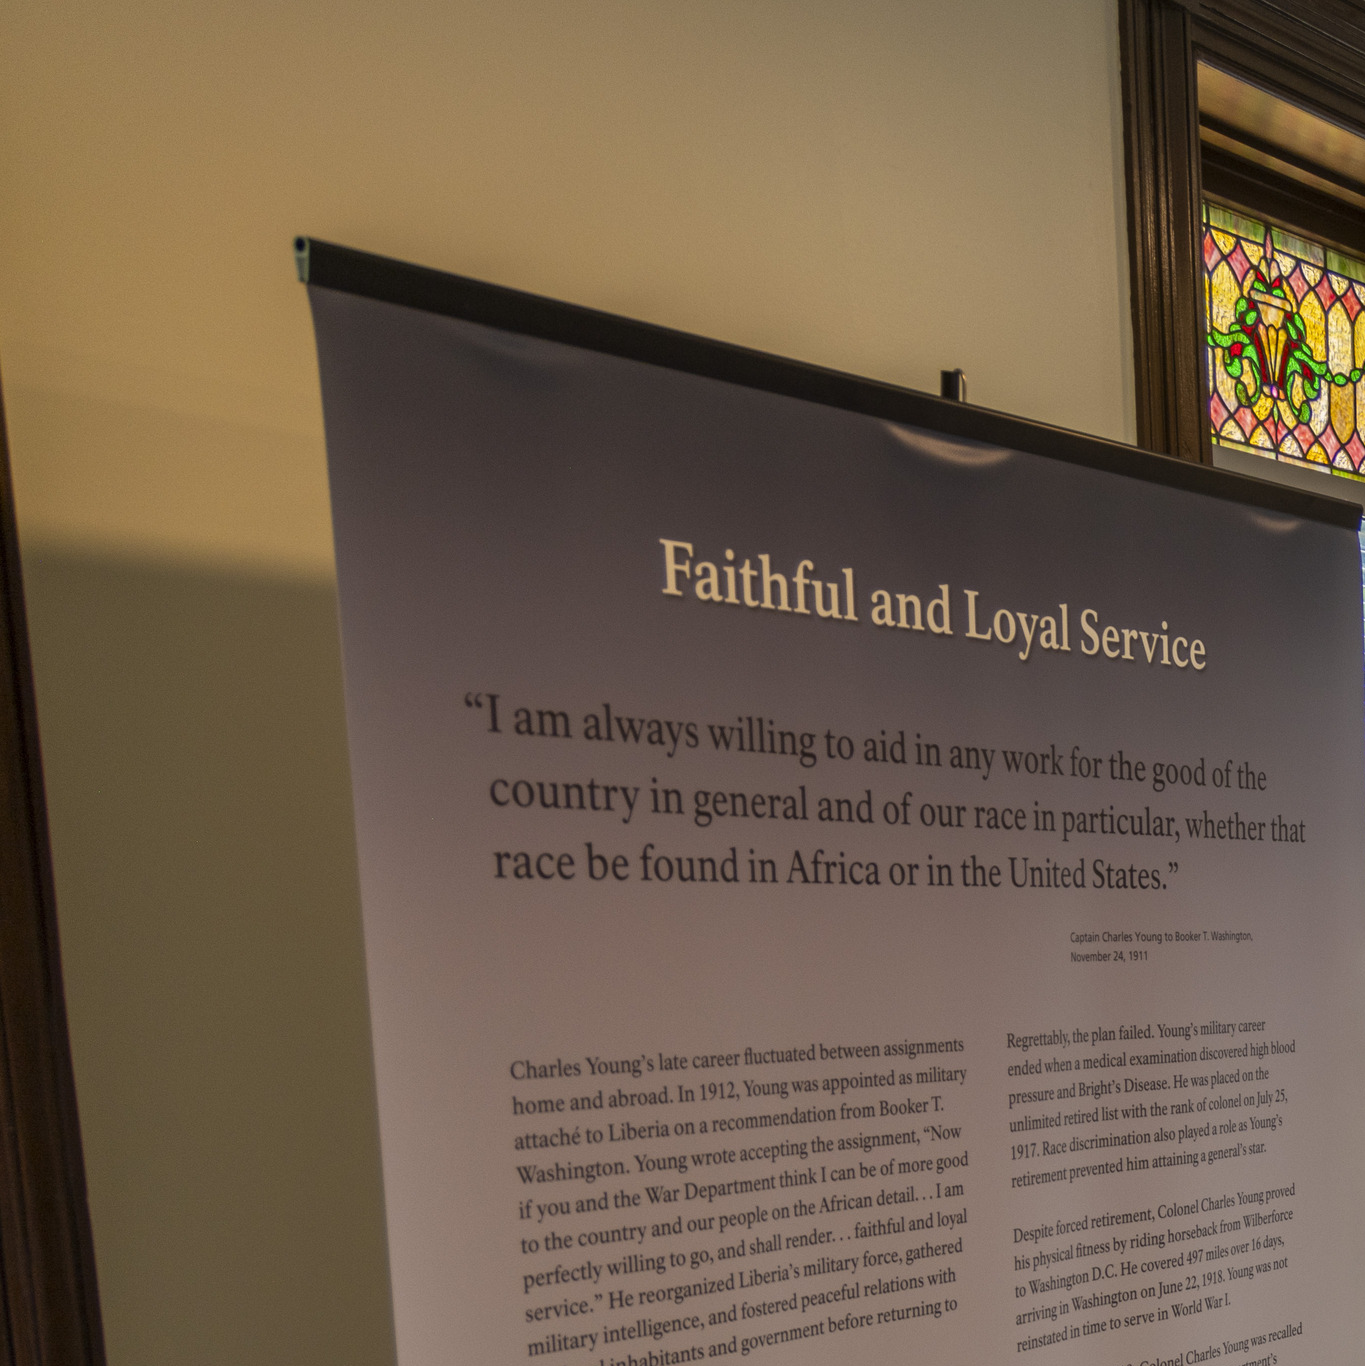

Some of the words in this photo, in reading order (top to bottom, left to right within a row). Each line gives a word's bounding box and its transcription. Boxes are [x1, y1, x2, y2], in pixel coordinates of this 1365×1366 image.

[659, 538, 858, 620] Faithful
[871, 584, 953, 634] and
[964, 589, 1071, 659] Loyal
[1080, 609, 1206, 669] Service
[464, 692, 502, 733] “I
[514, 708, 572, 739] am
[583, 703, 699, 758] always
[707, 716, 817, 768] willing
[824, 729, 855, 760] to
[864, 730, 907, 764] aid
[915, 733, 942, 767] in
[950, 746, 995, 781] any
[1002, 744, 1064, 776] work
[1070, 746, 1103, 778] for
[1108, 750, 1146, 782] the
[1152, 757, 1206, 792] good
[1212, 760, 1233, 788] of
[1237, 762, 1267, 791] the
[489, 778, 640, 824] country
[650, 777, 684, 815] in
[694, 785, 809, 828] general
[818, 789, 874, 824] and
[883, 791, 913, 825] of
[920, 804, 967, 828] our
[974, 807, 1026, 831] race
[1033, 801, 1056, 832] in
[1062, 805, 1180, 843] particular,
[1185, 810, 1266, 841] whether
[1271, 814, 1306, 843] that
[493, 851, 575, 881] race
[585, 842, 629, 881] be
[640, 843, 740, 883] found
[748, 848, 779, 883] in
[786, 849, 881, 886] Africa
[889, 863, 920, 886] or
[927, 854, 954, 886] in
[960, 855, 1001, 888] the
[1008, 857, 1086, 888] United
[1093, 859, 1178, 890] States.”
[1070, 932, 1100, 945] Captain
[1102, 931, 1133, 942] Charles
[1135, 931, 1163, 945] Young
[1164, 932, 1173, 942] to
[1175, 931, 1201, 942] Booker
[1202, 931, 1209, 941] T.
[1211, 931, 1253, 944] Washington,
[1070, 951, 1111, 962] November
[1113, 951, 1126, 963] 24,
[1129, 951, 1148, 961] 1911
[509, 1058, 582, 1080] Charles
[585, 1054, 655, 1078] Young’s
[658, 1052, 688, 1071] late
[692, 1053, 741, 1069] career
[744, 1044, 816, 1065] fluctuated
[819, 1043, 880, 1060] between
[884, 1039, 964, 1060] assignments
[1013, 1224, 1054, 1244] Despite
[1056, 1215, 1088, 1235] forced
[1091, 1209, 1155, 1229] retirement,
[1157, 1199, 1199, 1219] Colonel
[1201, 1194, 1235, 1212] Charles
[1237, 1192, 1264, 1205] Young
[1265, 1182, 1295, 1204] proved
